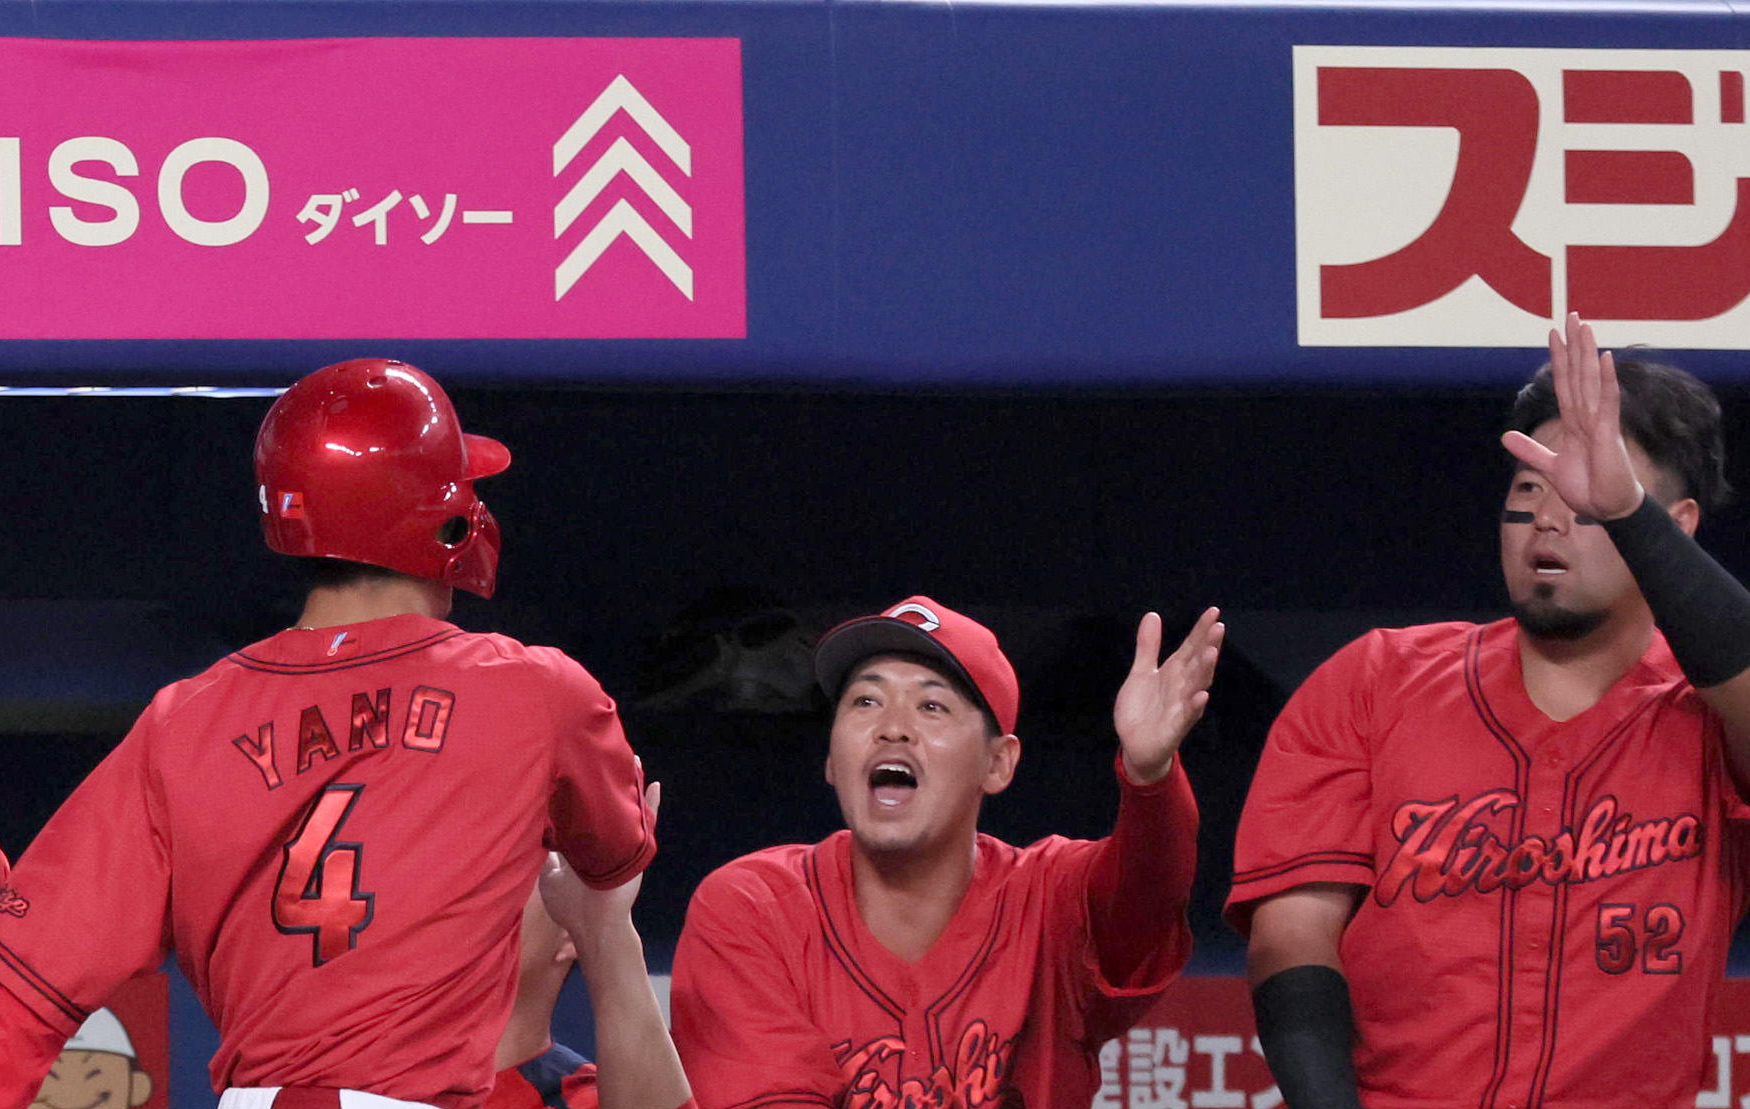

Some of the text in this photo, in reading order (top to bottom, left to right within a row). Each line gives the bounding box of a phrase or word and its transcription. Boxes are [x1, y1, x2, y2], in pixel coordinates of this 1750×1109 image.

[295, 187, 513, 245] ダイソー
[231, 684, 457, 791] YANO
[270, 782, 377, 969] 4
[1374, 788, 1705, 909] Hiroshima
[1595, 902, 1687, 975] 52
